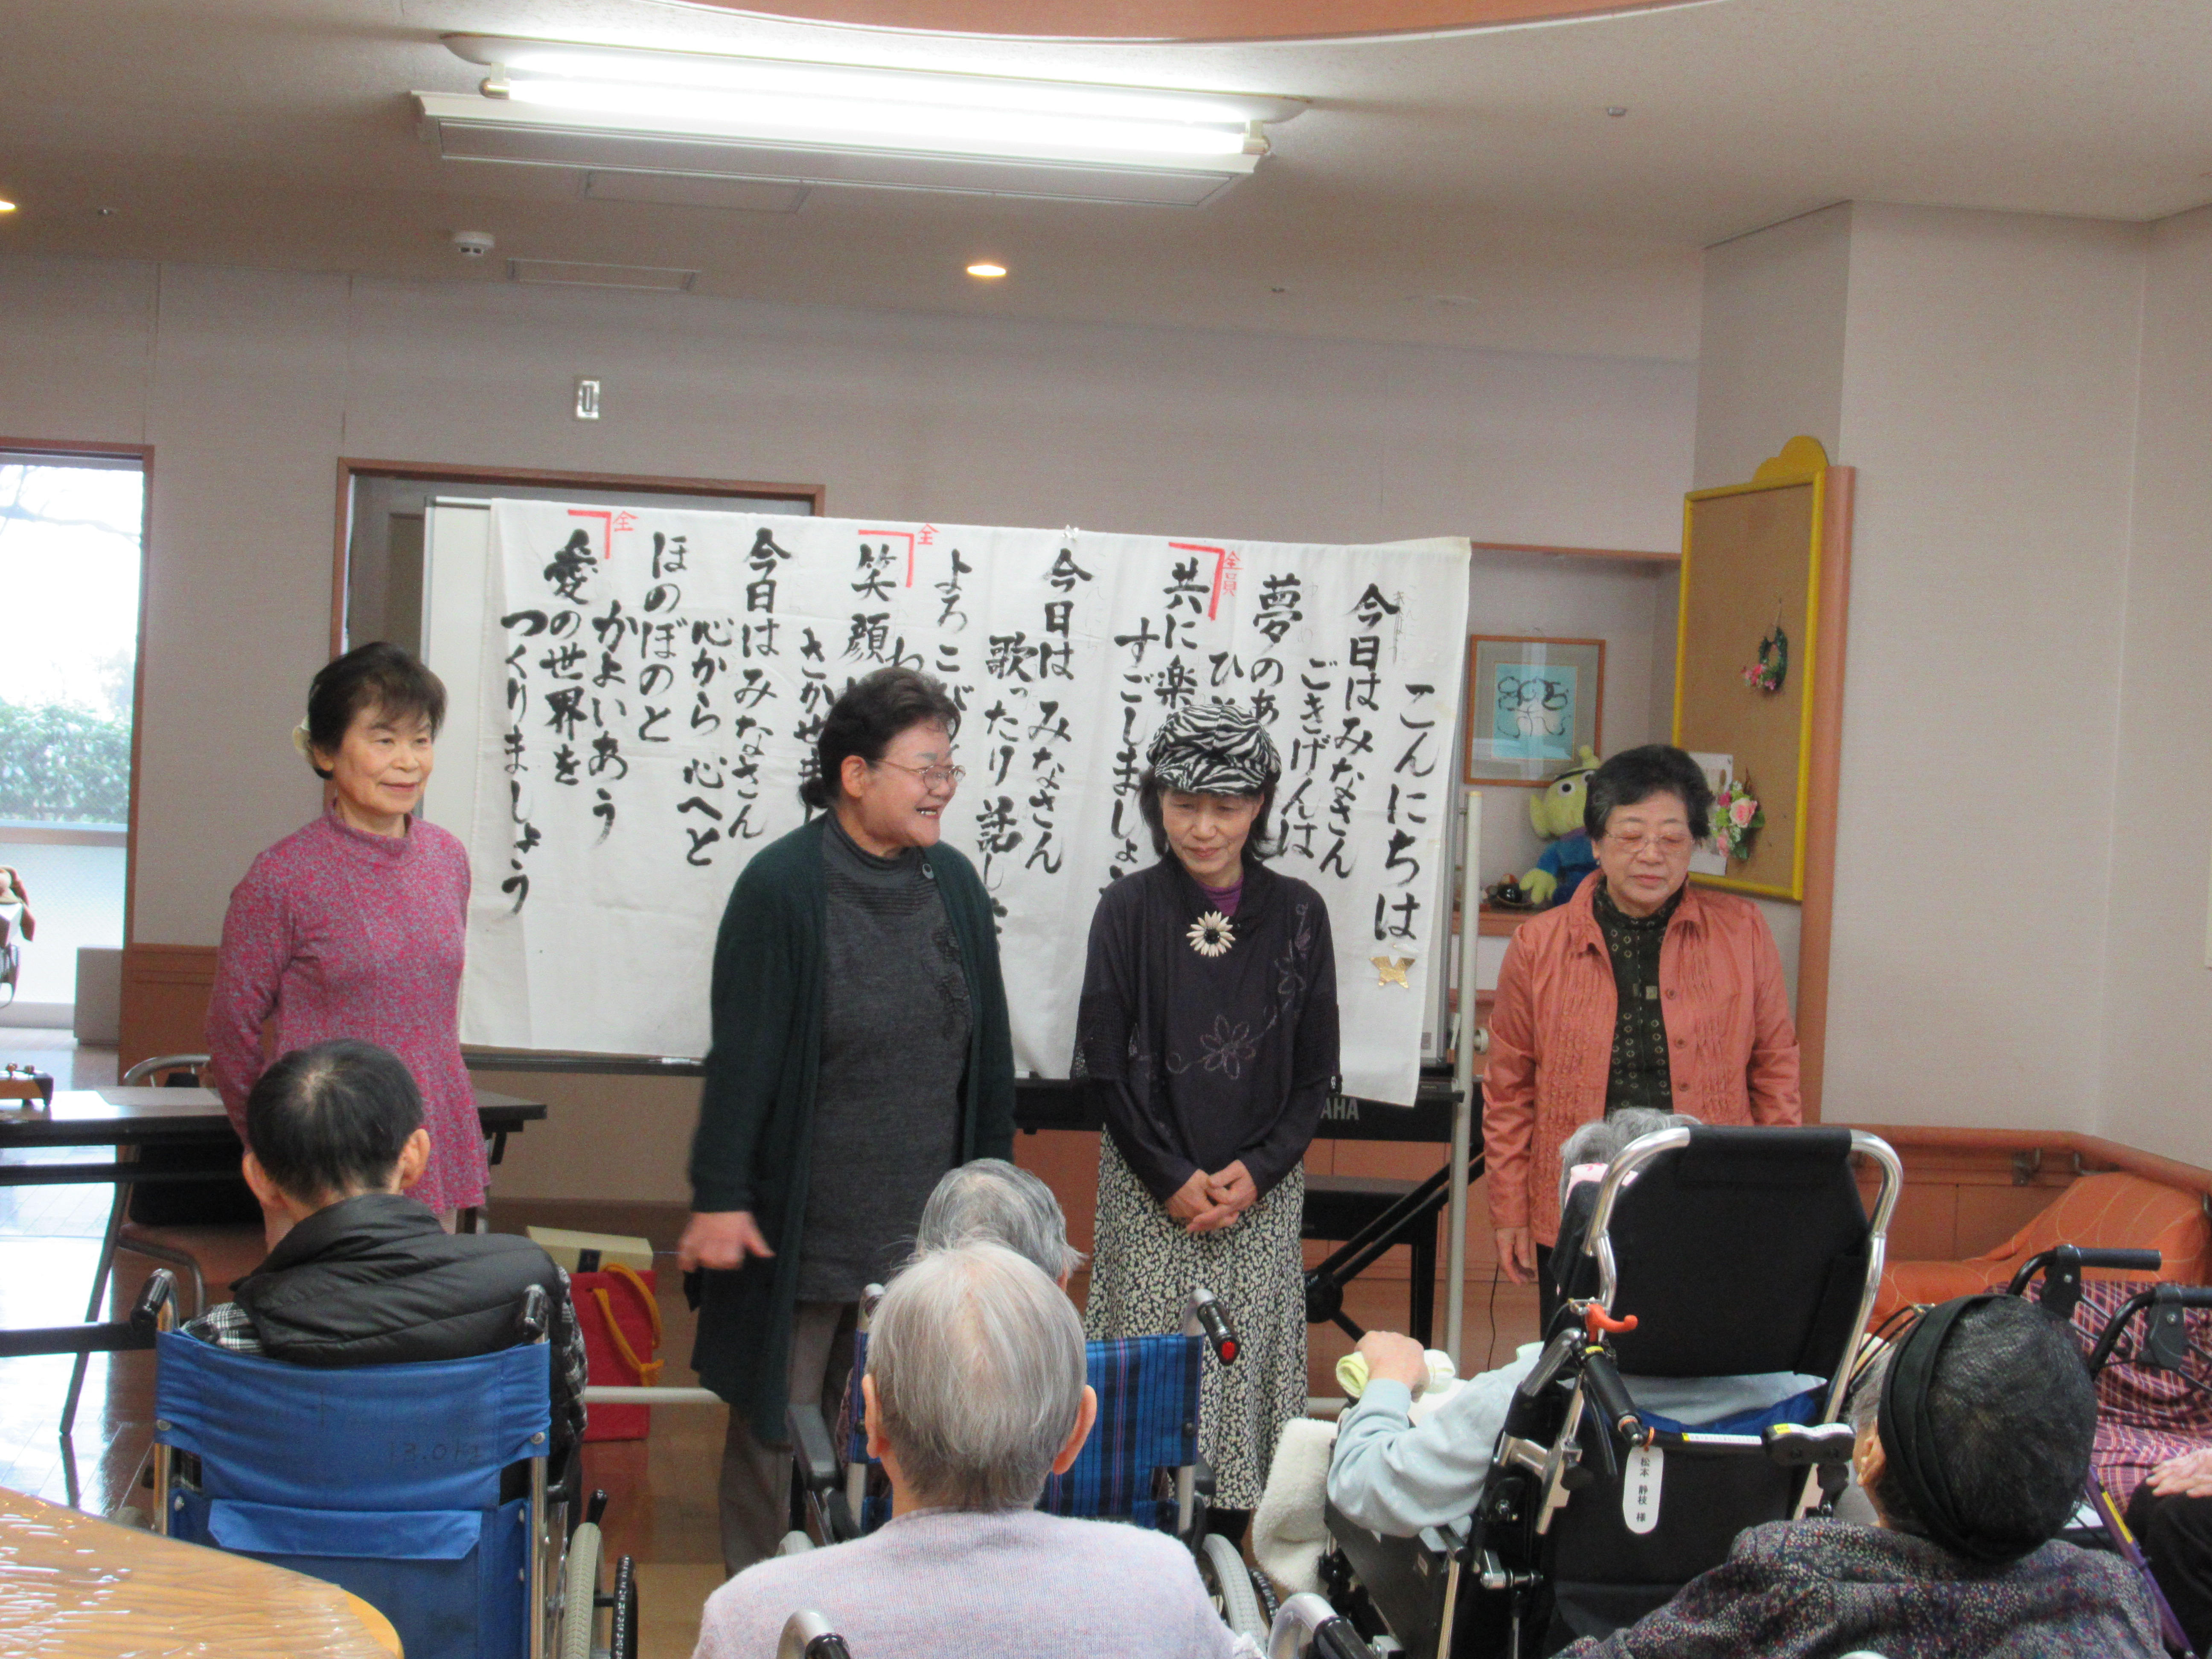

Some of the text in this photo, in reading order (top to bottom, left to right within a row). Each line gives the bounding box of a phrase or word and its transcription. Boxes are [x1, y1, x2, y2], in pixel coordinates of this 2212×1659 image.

[613, 510, 640, 532] 全
[638, 531, 688, 742] ほのぼのと
[839, 543, 897, 695] 笑顔
[917, 524, 940, 545] 全
[1222, 550, 1244, 597] 全員
[501, 610, 549, 917] つくりましょう
[539, 529, 598, 786] 愛の世界を
[588, 599, 637, 847] かよいあう
[728, 528, 792, 839] 今日はみなさん
[1099, 617, 1160, 895] すごしましょ
[1280, 658, 1338, 859] ごきげんは
[1318, 583, 1401, 879] 今日はみなさん
[1374, 684, 1439, 940] こんにちは
